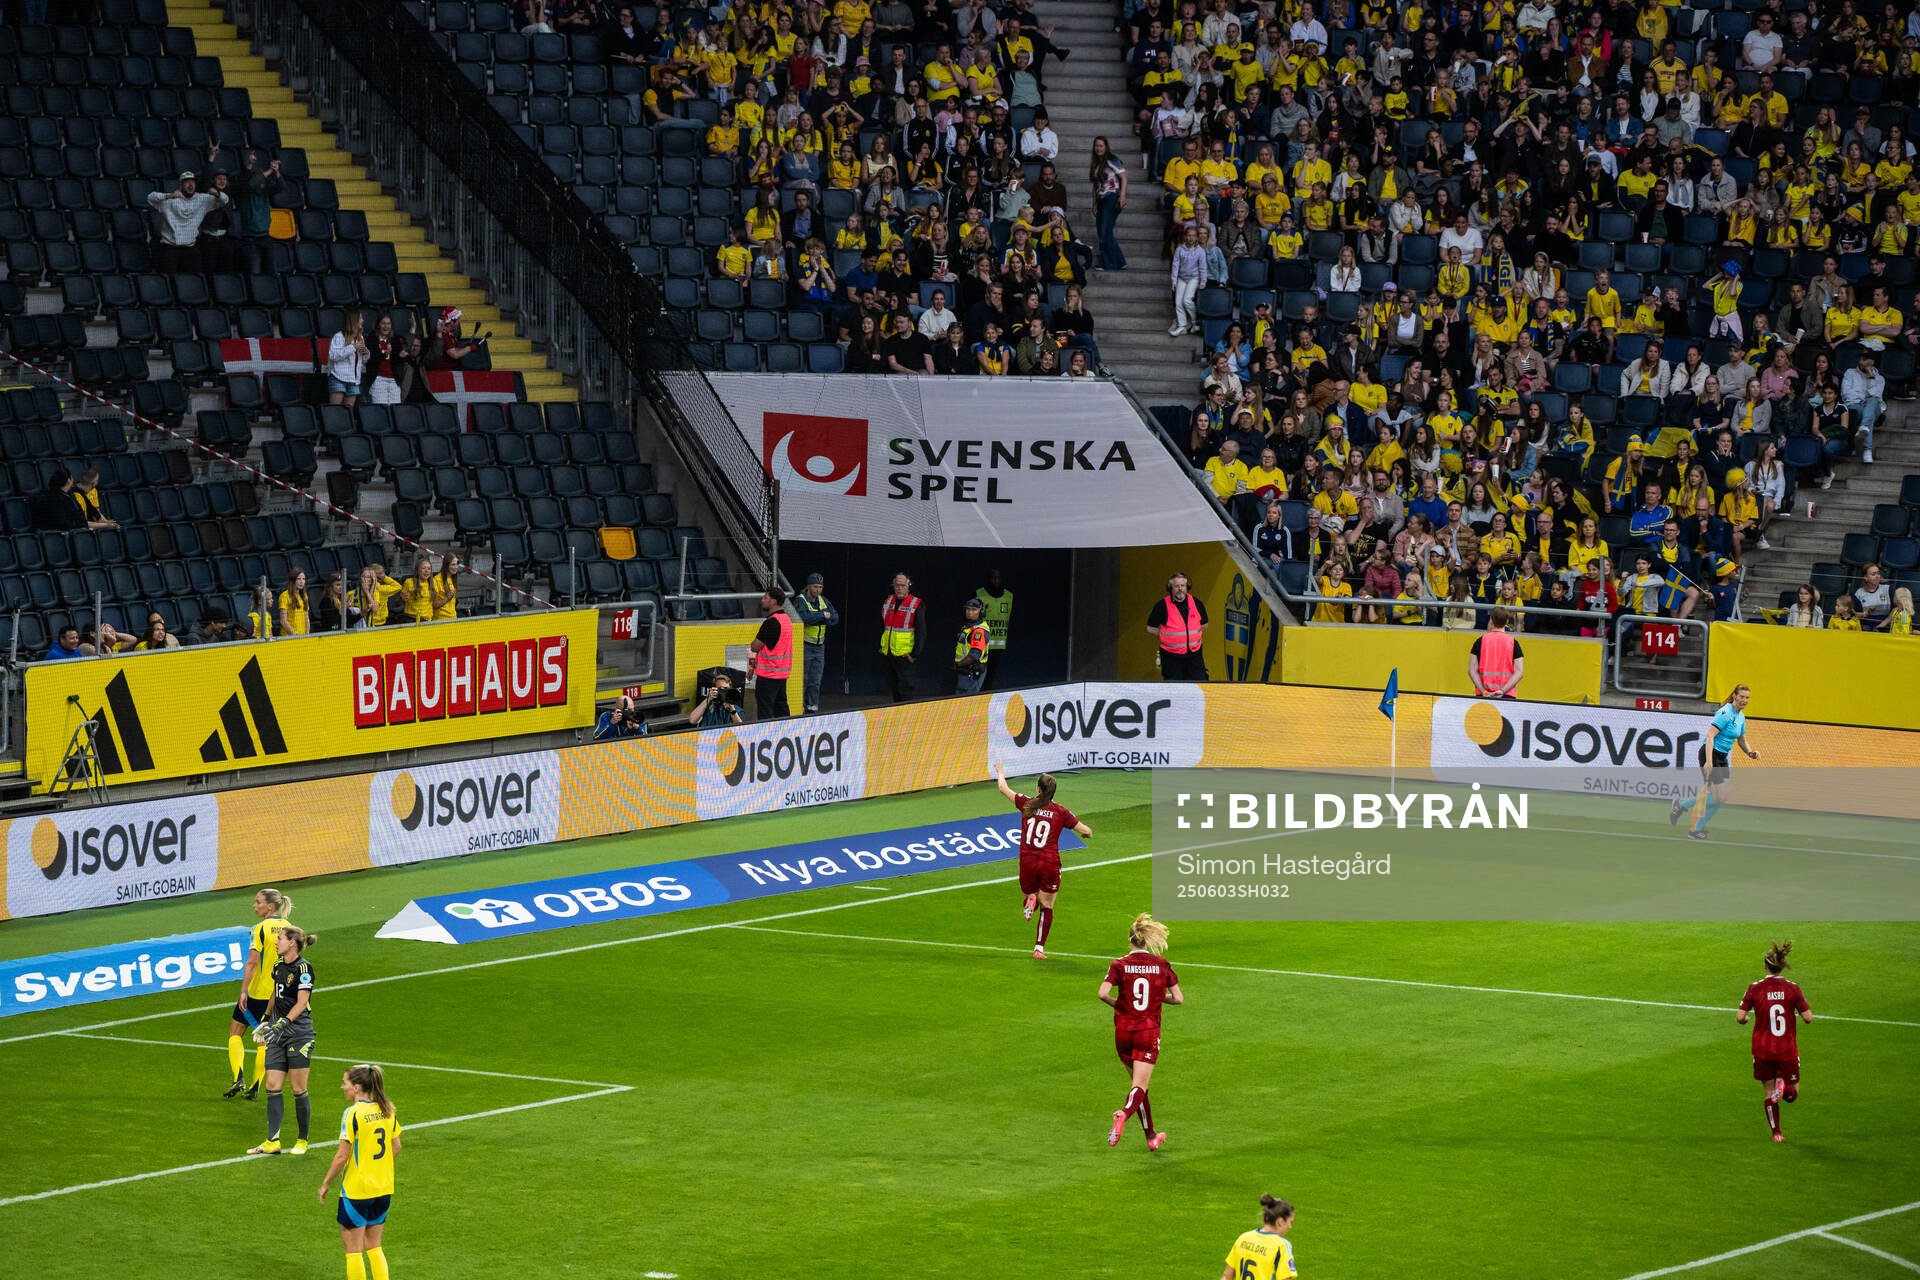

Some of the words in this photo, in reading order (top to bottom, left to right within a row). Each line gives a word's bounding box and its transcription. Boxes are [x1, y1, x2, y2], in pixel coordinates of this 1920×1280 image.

[889, 438, 1136, 471] SVENSKA
[888, 472, 1013, 504] SPEL
[614, 617, 633, 633] 118
[1645, 631, 1676, 648] 114
[357, 646, 563, 714] BAUHAUS
[626, 687, 638, 697] 118
[1643, 700, 1663, 710] 114
[1067, 752, 1170, 766] SAINT-GOBAIN
[785, 785, 849, 806] SAINT-GOBAIN
[1584, 777, 1698, 798] SAINT-GOBAIN
[468, 828, 540, 850] SAINT-GOBAIN
[1026, 817, 1051, 848] 19
[738, 855, 847, 885] Nya
[842, 827, 1022, 870] bostäde
[117, 876, 196, 900] SAINT-GOBAIN
[533, 876, 691, 918] OBOS
[14, 943, 244, 1003] Sverige!
[1133, 977, 1150, 1012] 9
[1769, 1004, 1786, 1037] 6
[373, 1127, 386, 1160] 3
[1240, 1257, 1257, 1280] 16
